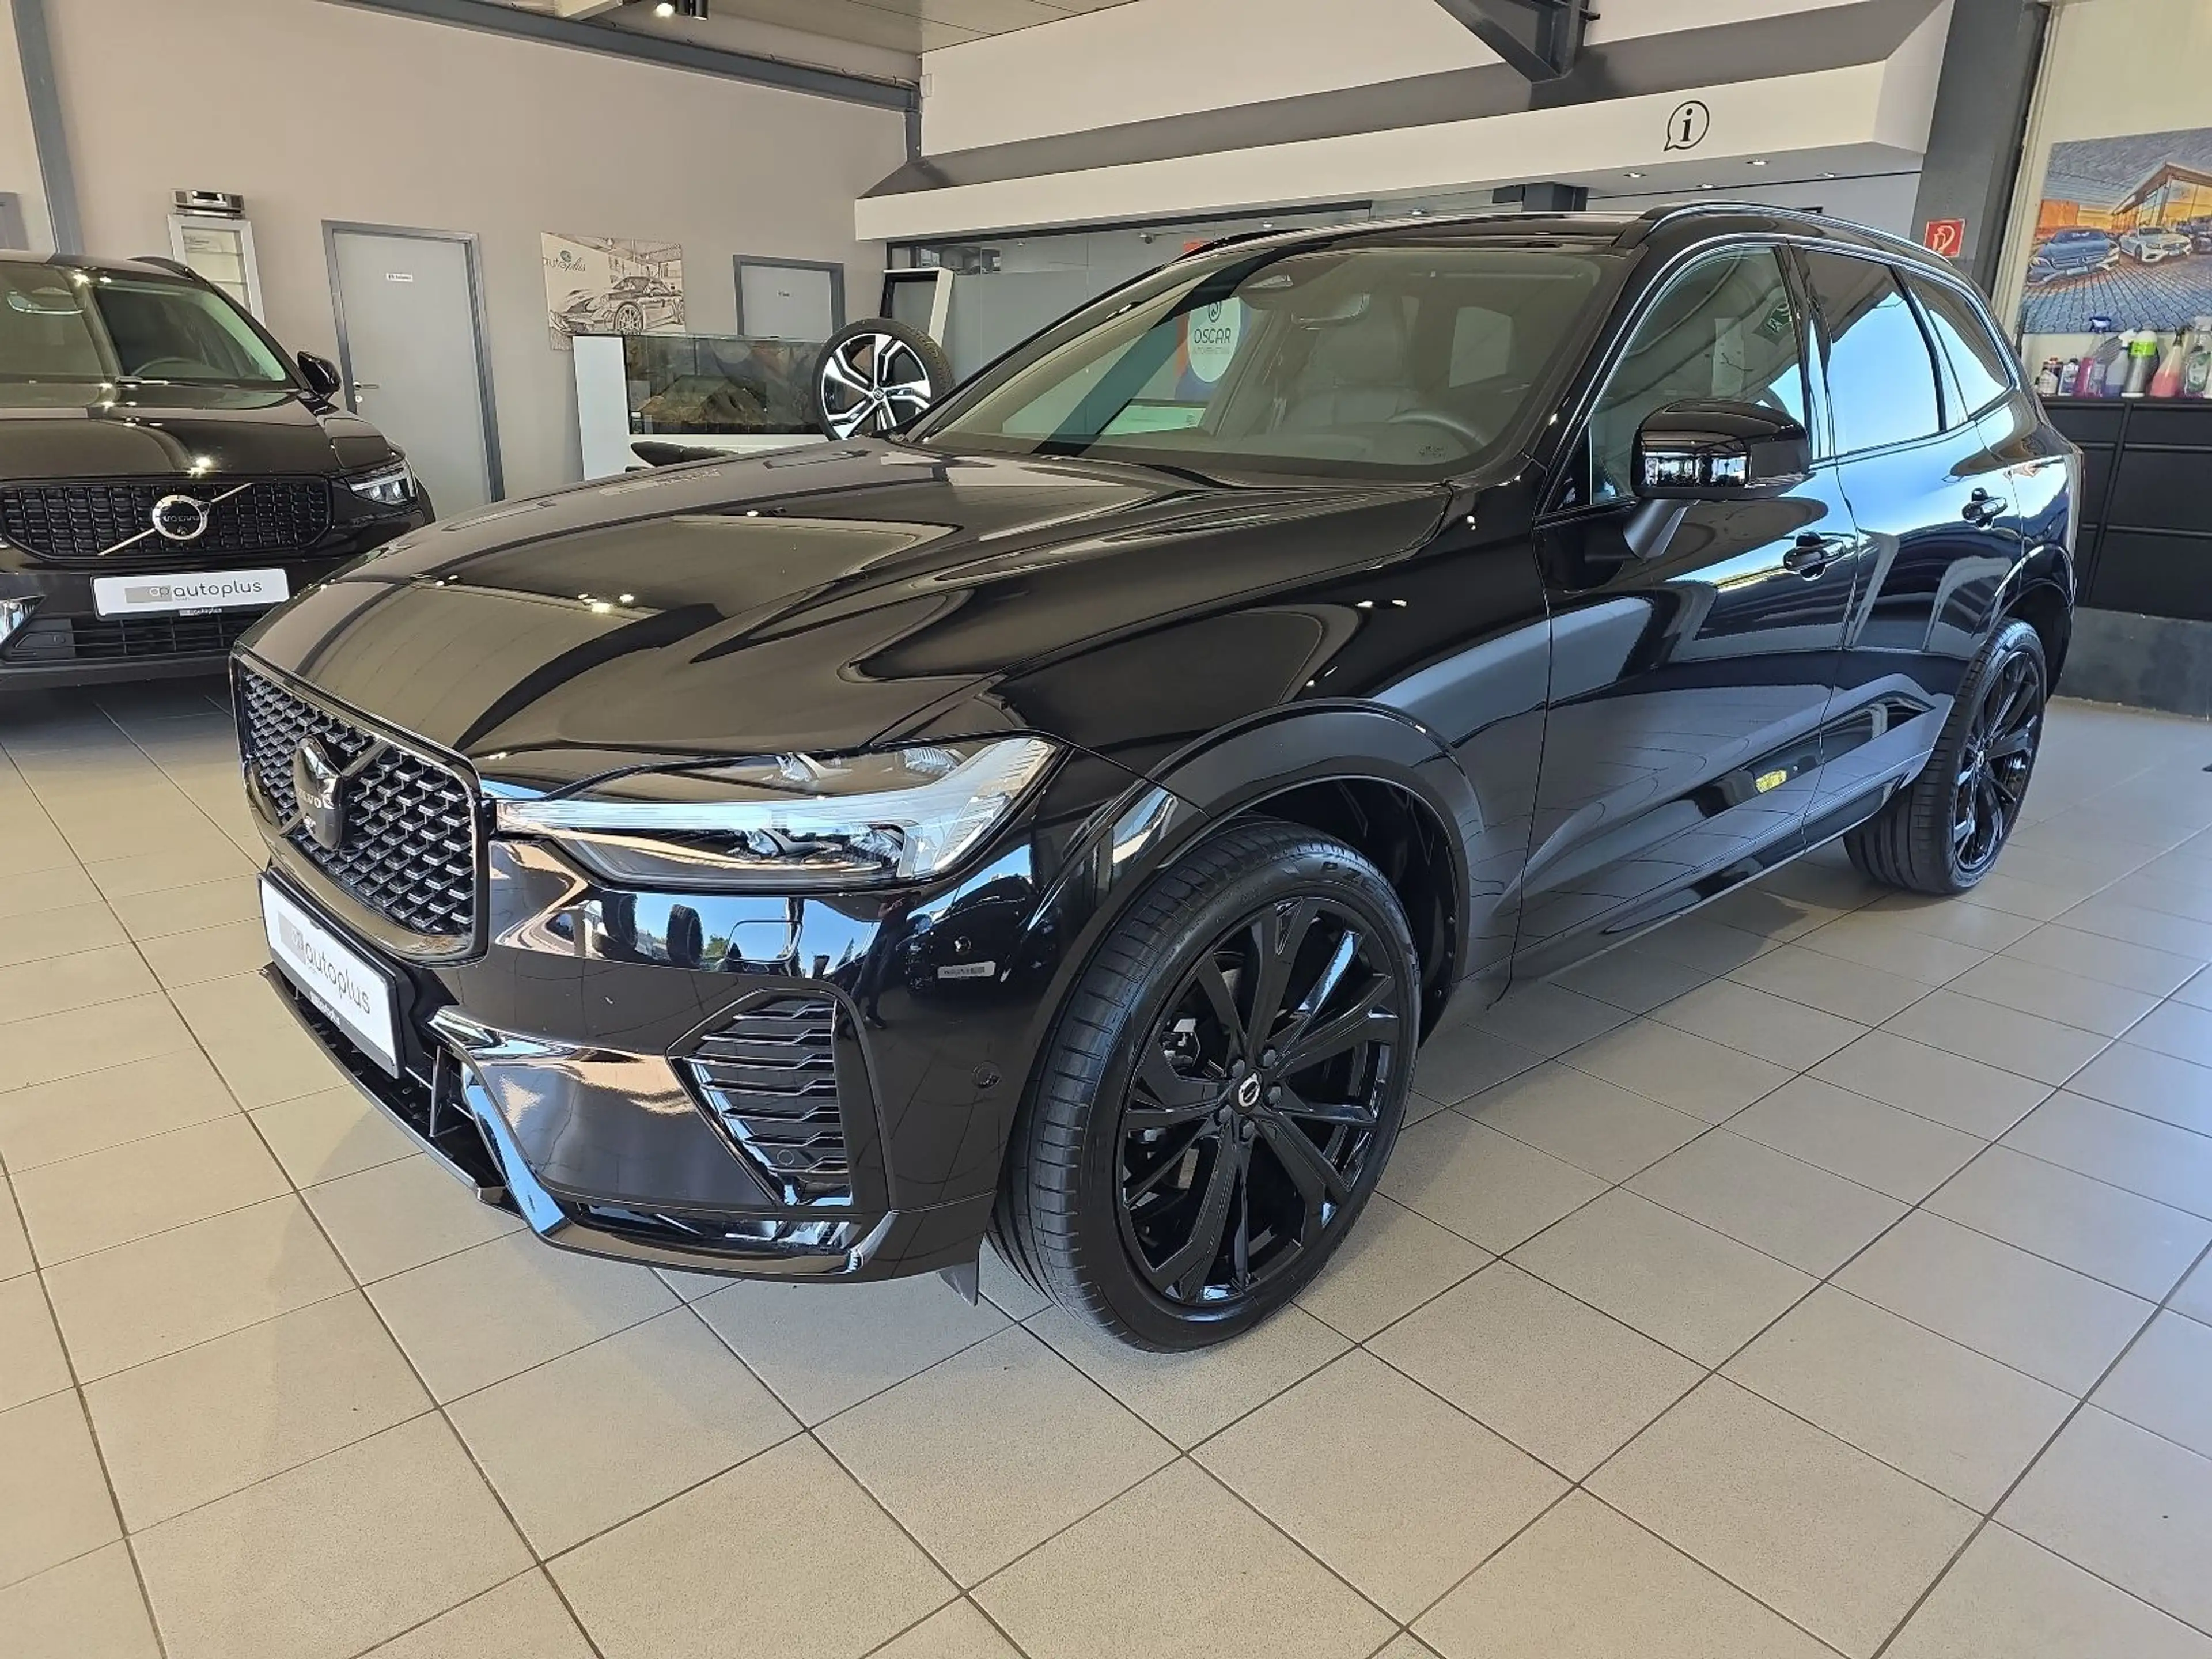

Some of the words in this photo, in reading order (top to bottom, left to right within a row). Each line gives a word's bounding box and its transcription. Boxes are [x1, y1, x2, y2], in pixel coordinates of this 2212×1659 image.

[1194, 327, 1232, 344] OSCAR
[173, 580, 263, 598] autoplus
[305, 942, 370, 1014] autoplus
